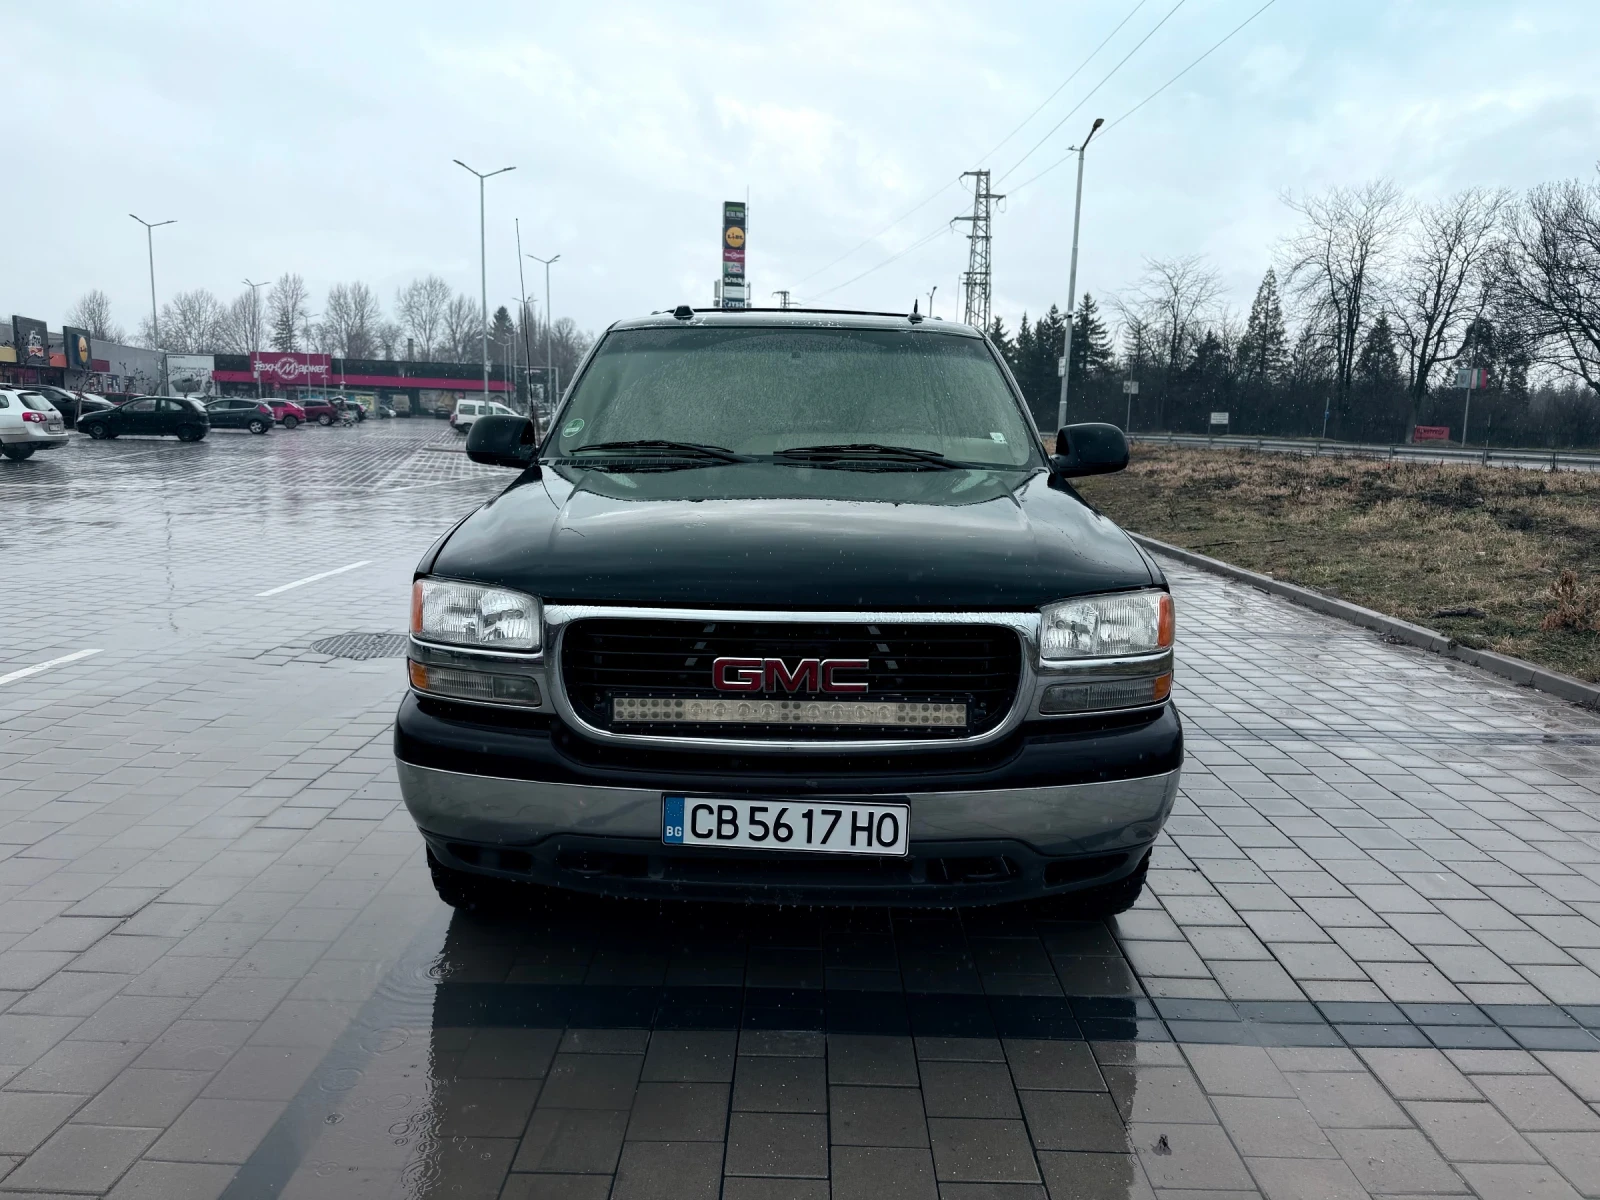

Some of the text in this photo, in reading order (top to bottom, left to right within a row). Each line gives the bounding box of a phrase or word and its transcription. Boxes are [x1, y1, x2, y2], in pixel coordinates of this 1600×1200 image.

[712, 657, 870, 693] GMC
[666, 825, 682, 837] BG
[691, 803, 739, 840] CB
[748, 806, 843, 845] 5617
